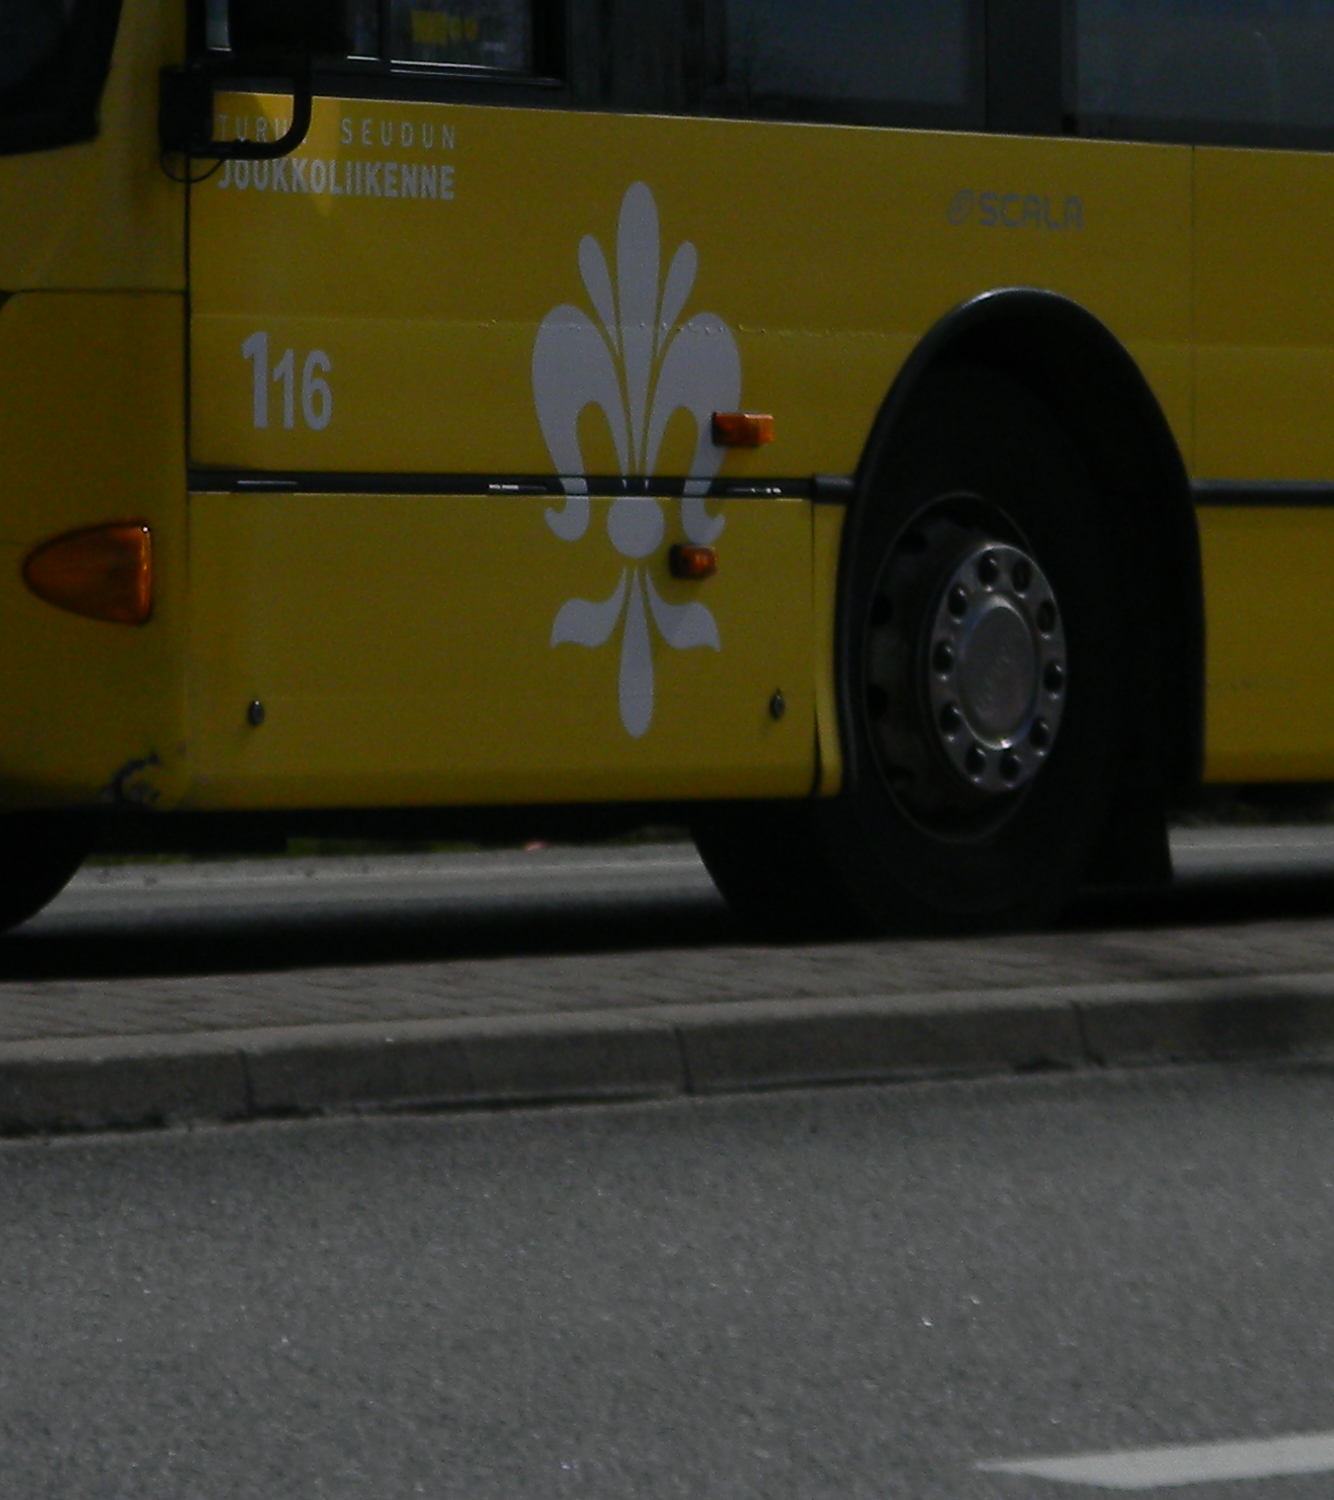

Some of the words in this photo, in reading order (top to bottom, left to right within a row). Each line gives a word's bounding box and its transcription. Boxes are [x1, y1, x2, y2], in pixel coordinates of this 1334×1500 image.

[218, 114, 306, 144] TURU
[340, 116, 456, 150] SEUDUN
[217, 157, 456, 201] JOUKKOLIIKENNE
[979, 190, 1085, 231] SCALA
[240, 331, 333, 432] 116
